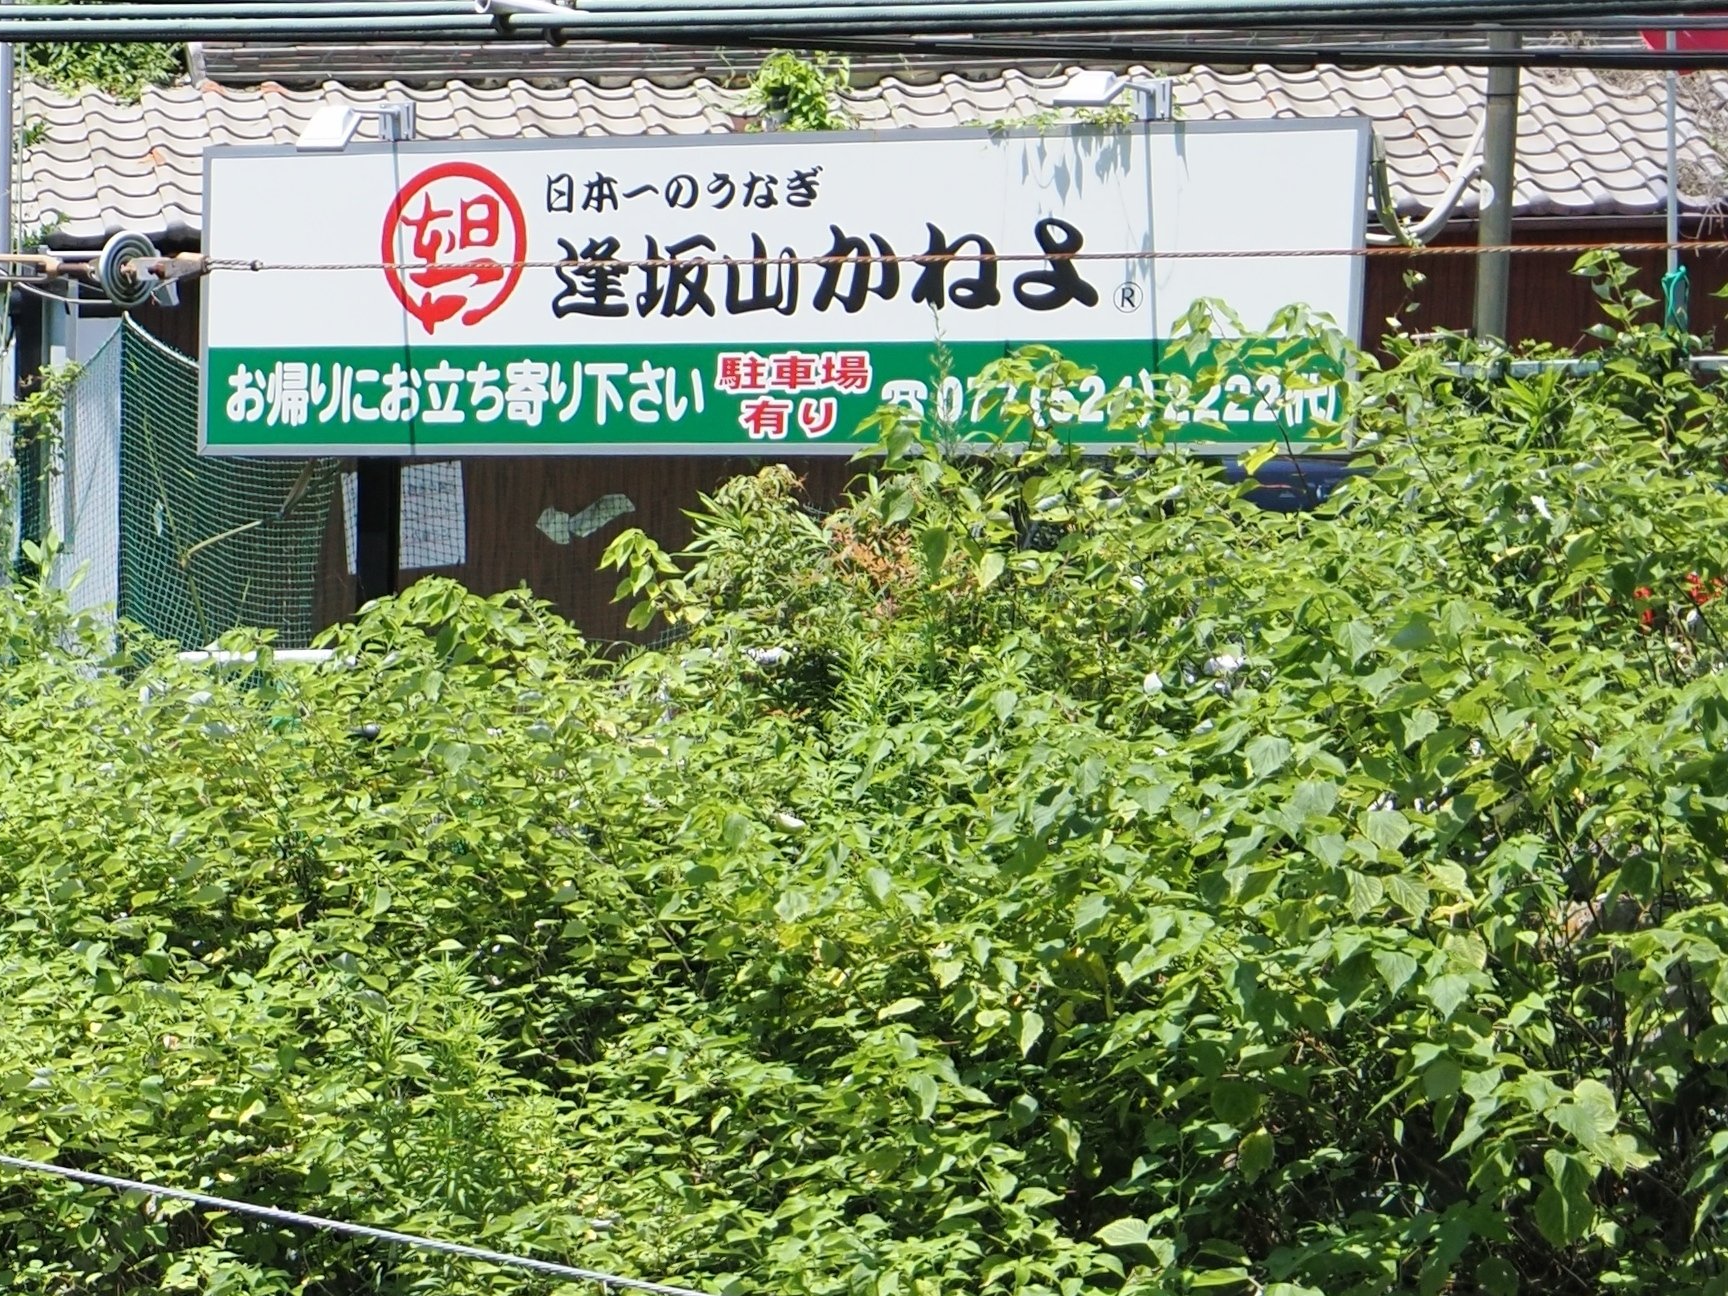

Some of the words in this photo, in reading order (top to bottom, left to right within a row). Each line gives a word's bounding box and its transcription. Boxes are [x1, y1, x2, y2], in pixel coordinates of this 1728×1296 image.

[545, 165, 824, 214] 日本一のうなぎ
[551, 216, 1100, 319] 逢坂山かねよ
[226, 359, 704, 427] お帰りにお立ち寄り下さい
[716, 352, 872, 394] 駐車場
[739, 397, 837, 439] 有り
